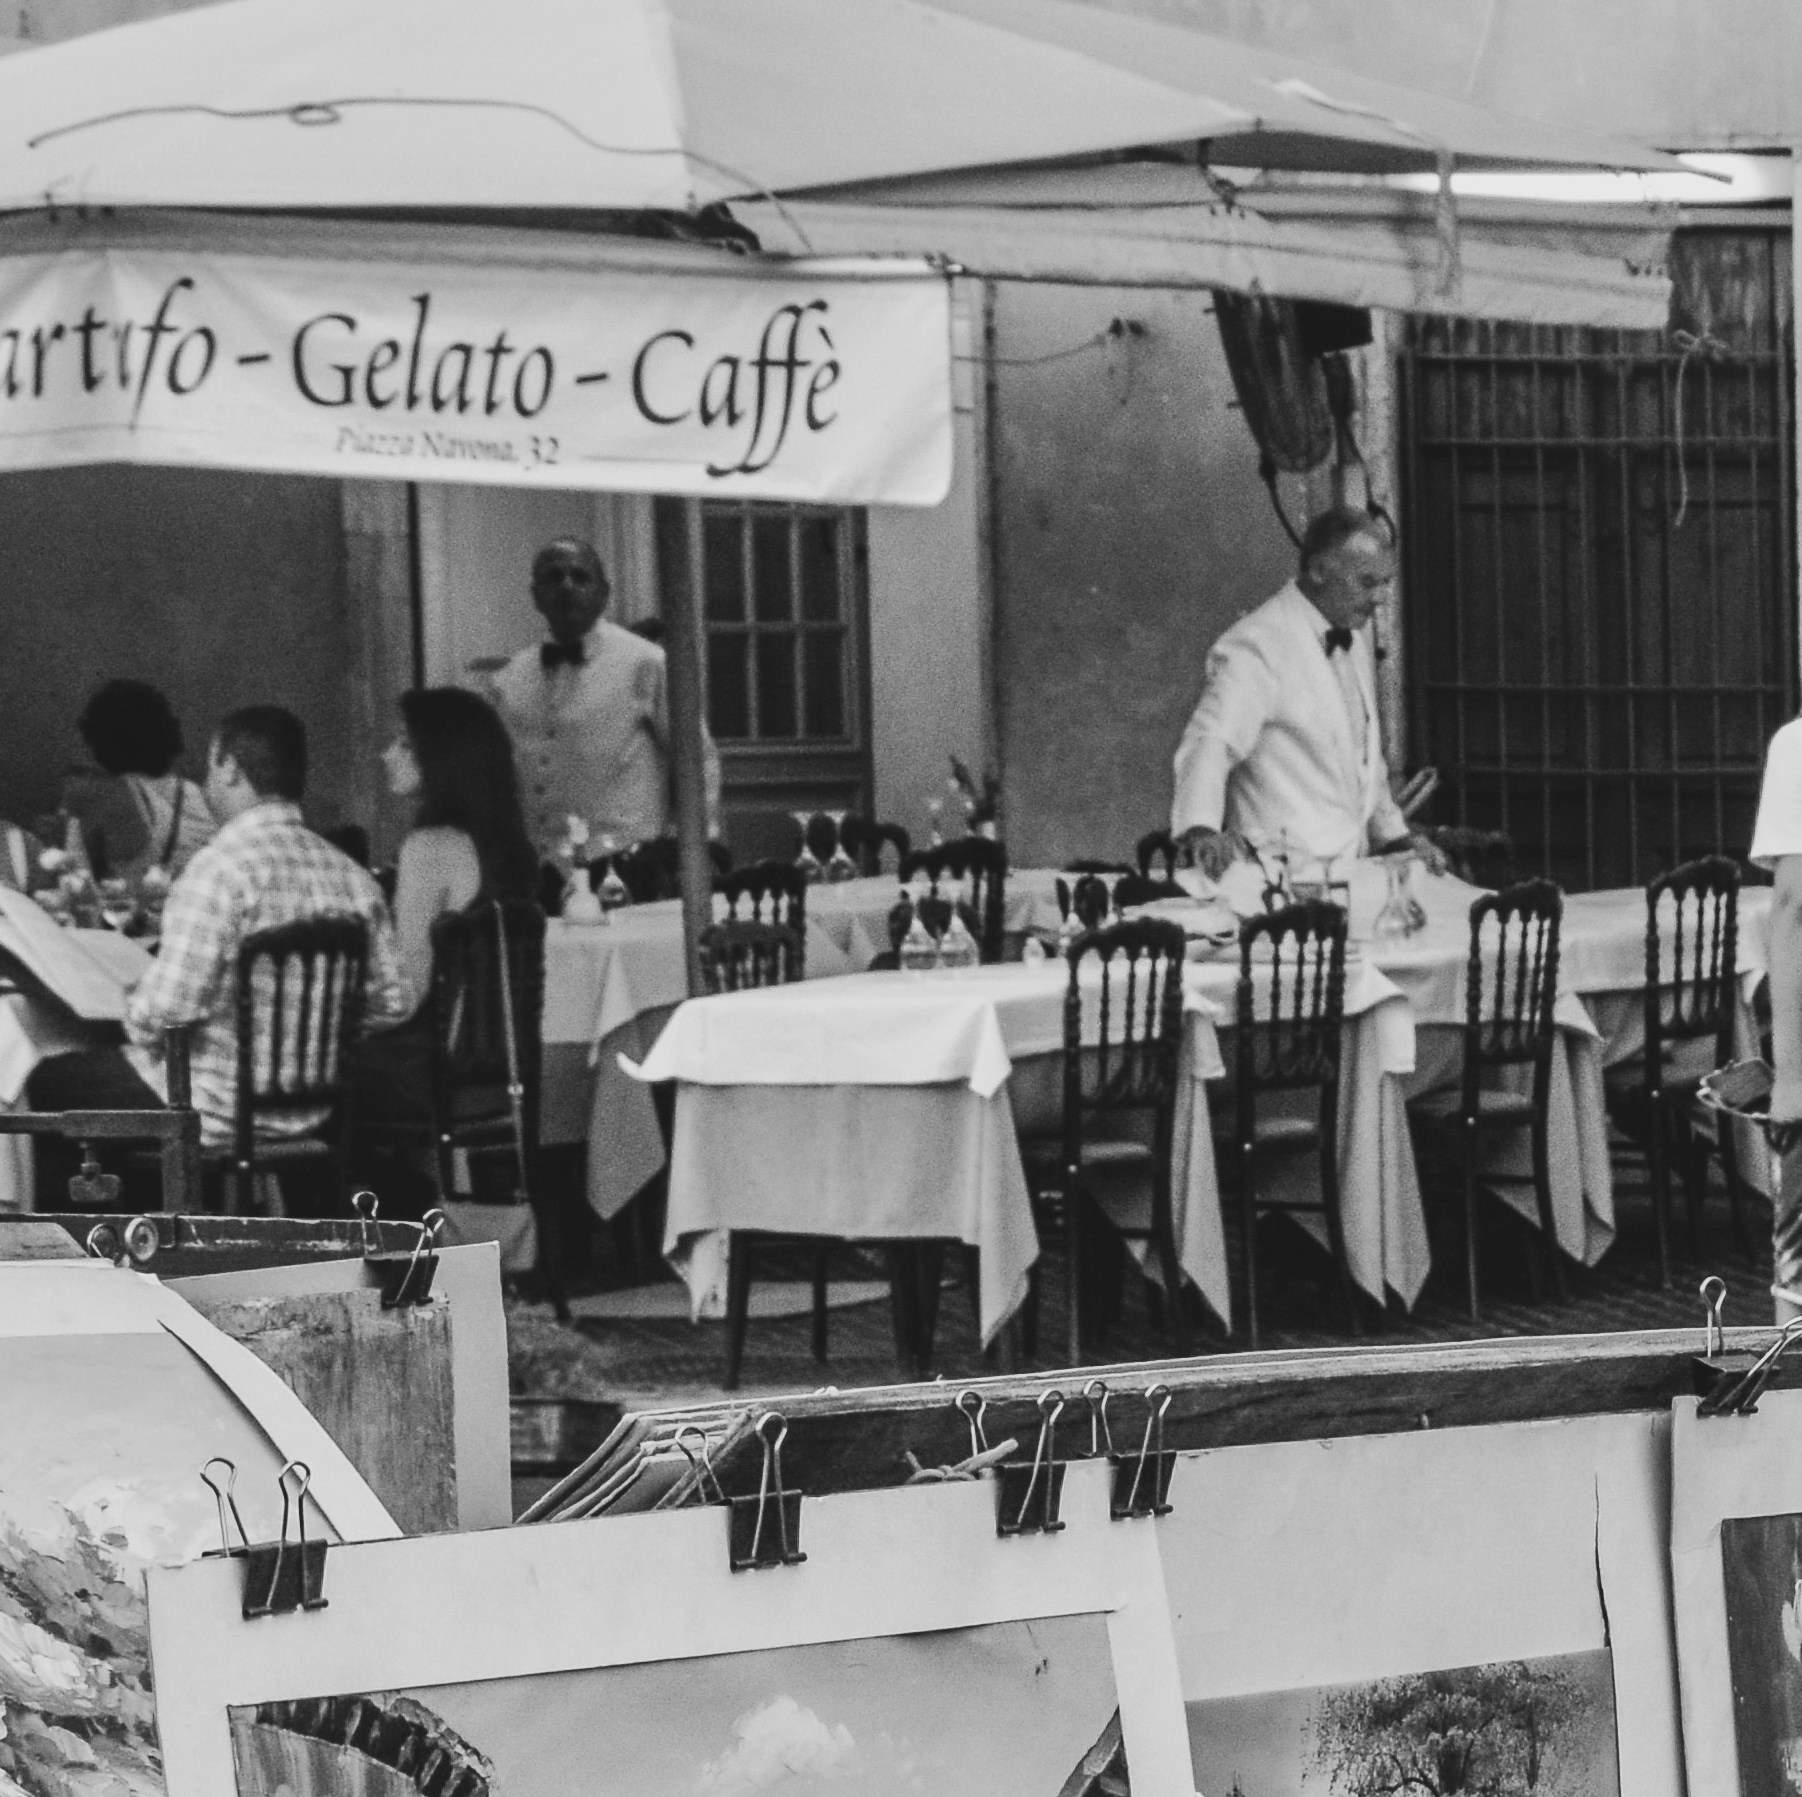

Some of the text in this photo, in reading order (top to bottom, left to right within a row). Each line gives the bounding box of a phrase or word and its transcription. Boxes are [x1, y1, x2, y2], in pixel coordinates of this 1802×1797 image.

[292, 292, 554, 419] Gelato
[631, 299, 842, 479] Caffè
[335, 425, 415, 457] Piazza
[524, 435, 560, 471] 32
